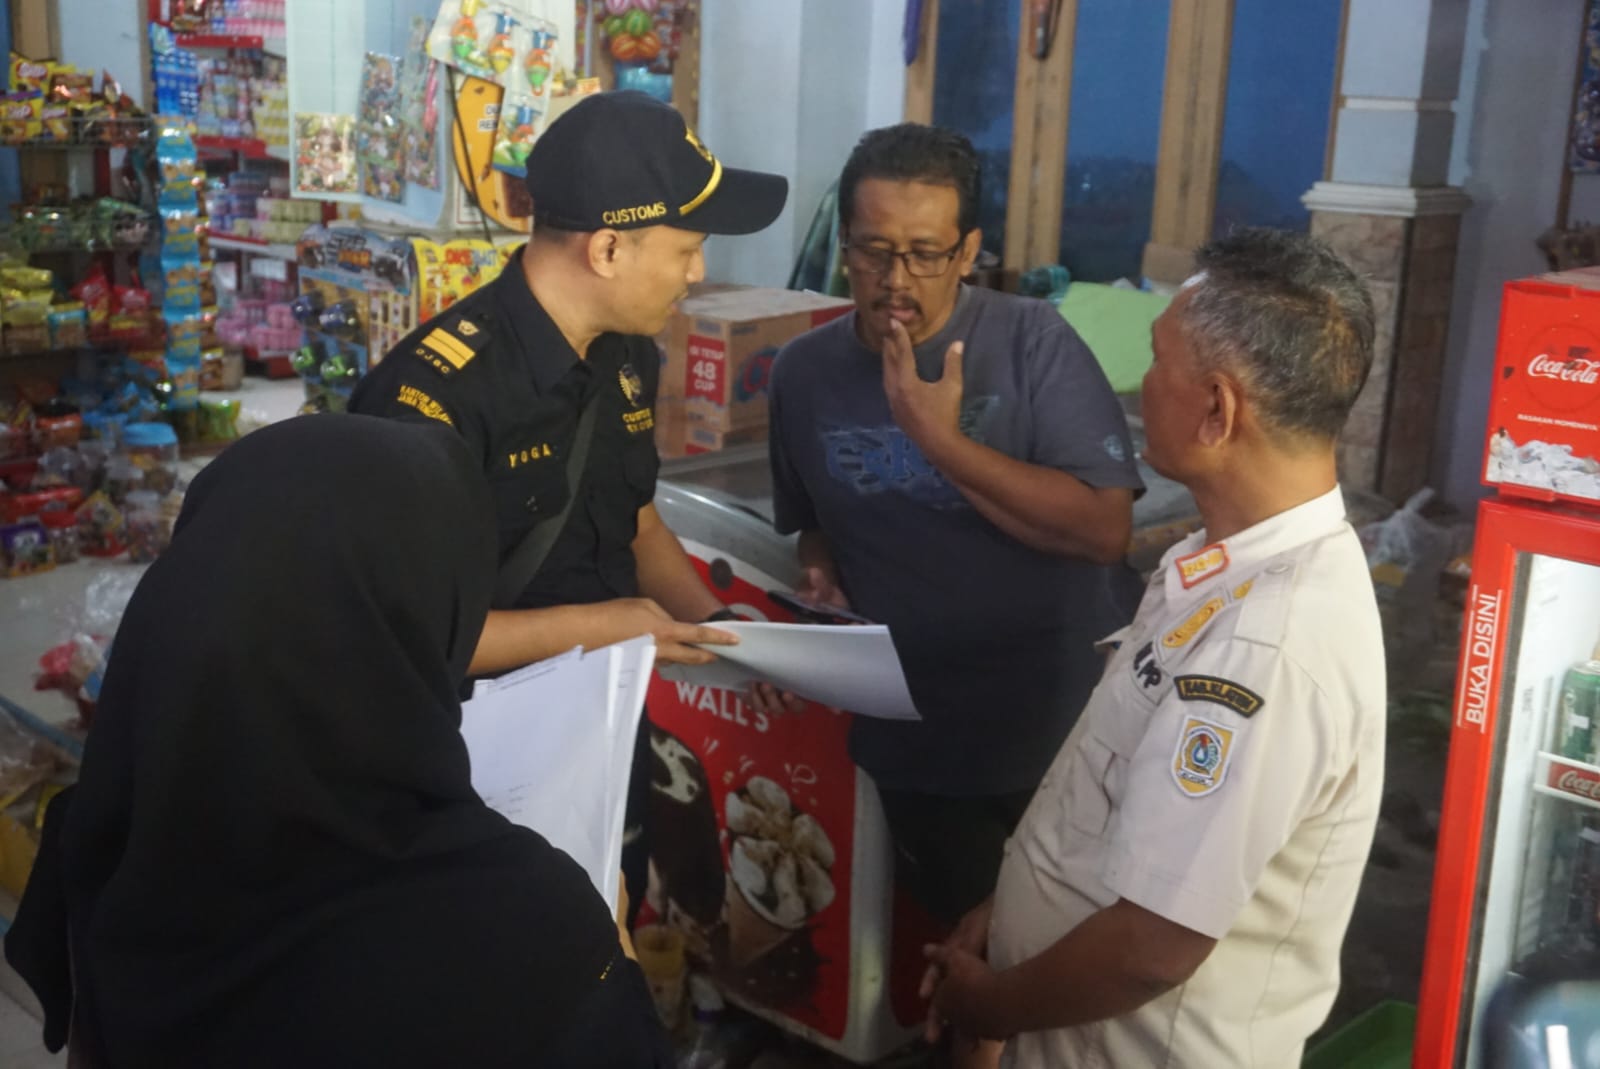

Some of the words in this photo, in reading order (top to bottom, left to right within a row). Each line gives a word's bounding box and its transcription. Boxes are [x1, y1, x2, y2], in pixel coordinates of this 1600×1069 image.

[602, 201, 667, 225] CUSTOMS
[692, 360, 716, 380] 48
[509, 443, 552, 469] YOGA
[1473, 593, 1498, 658] DISINI
[675, 680, 769, 733] WALL'S
[1465, 664, 1489, 724] BUKA
